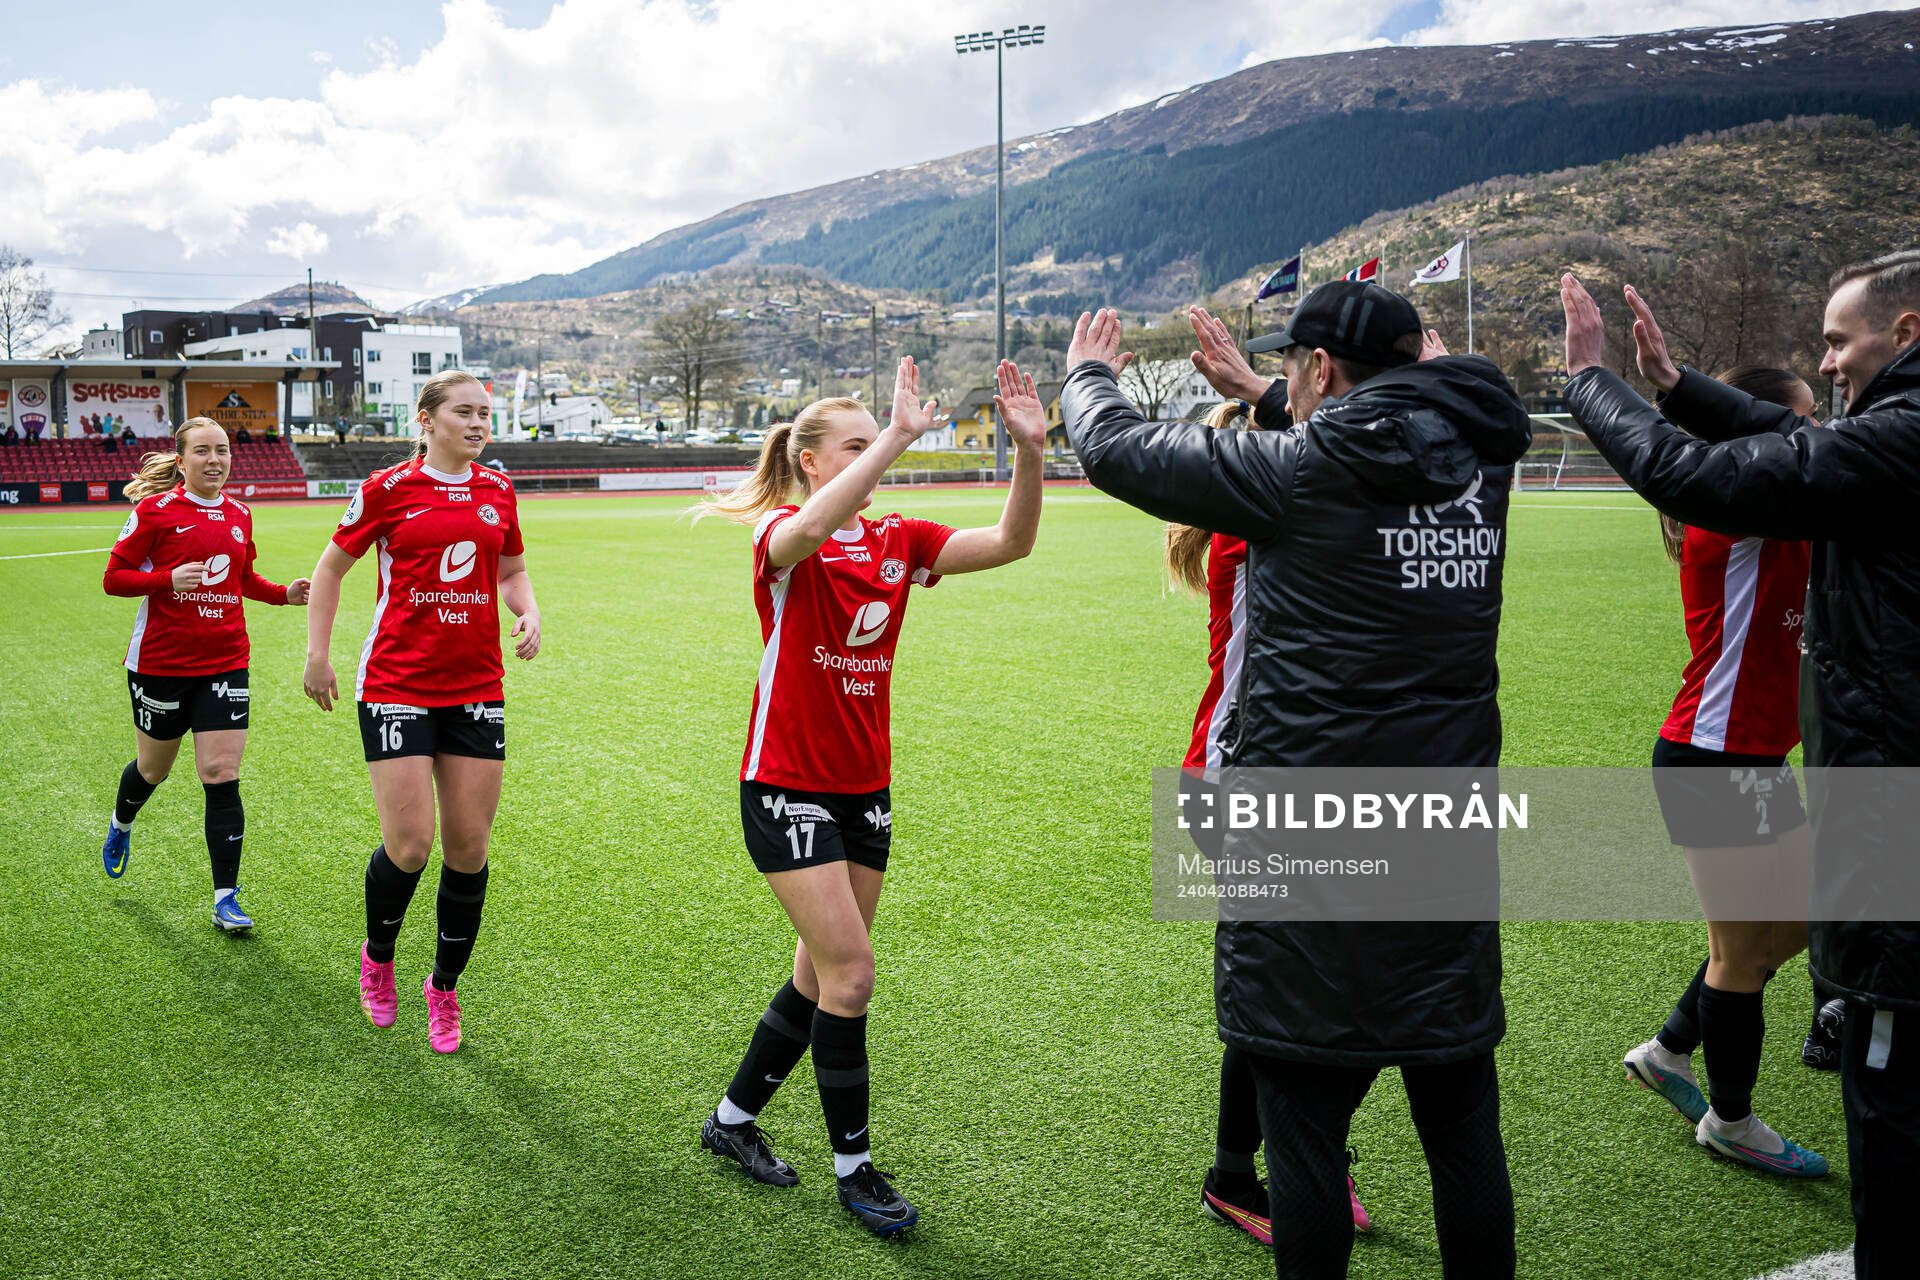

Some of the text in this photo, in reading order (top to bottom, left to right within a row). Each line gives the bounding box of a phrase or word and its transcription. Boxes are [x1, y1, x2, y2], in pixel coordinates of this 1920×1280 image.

[382, 472, 405, 491] KIWI
[479, 472, 501, 485] KIWI
[448, 492, 472, 502] RSM
[208, 513, 225, 521] RSM
[1376, 528, 1501, 557] TORSHOV
[1401, 560, 1489, 589] SPORT
[173, 590, 239, 604] Sparebanken
[409, 587, 489, 607] Sparebanken
[198, 605, 223, 619] Vest
[437, 608, 469, 624] Vest
[812, 645, 892, 673] Sparebank
[842, 677, 876, 696] Vest
[137, 708, 152, 731] 13
[379, 721, 403, 752] 16
[1755, 800, 1770, 835] 2
[785, 822, 815, 860] 17
